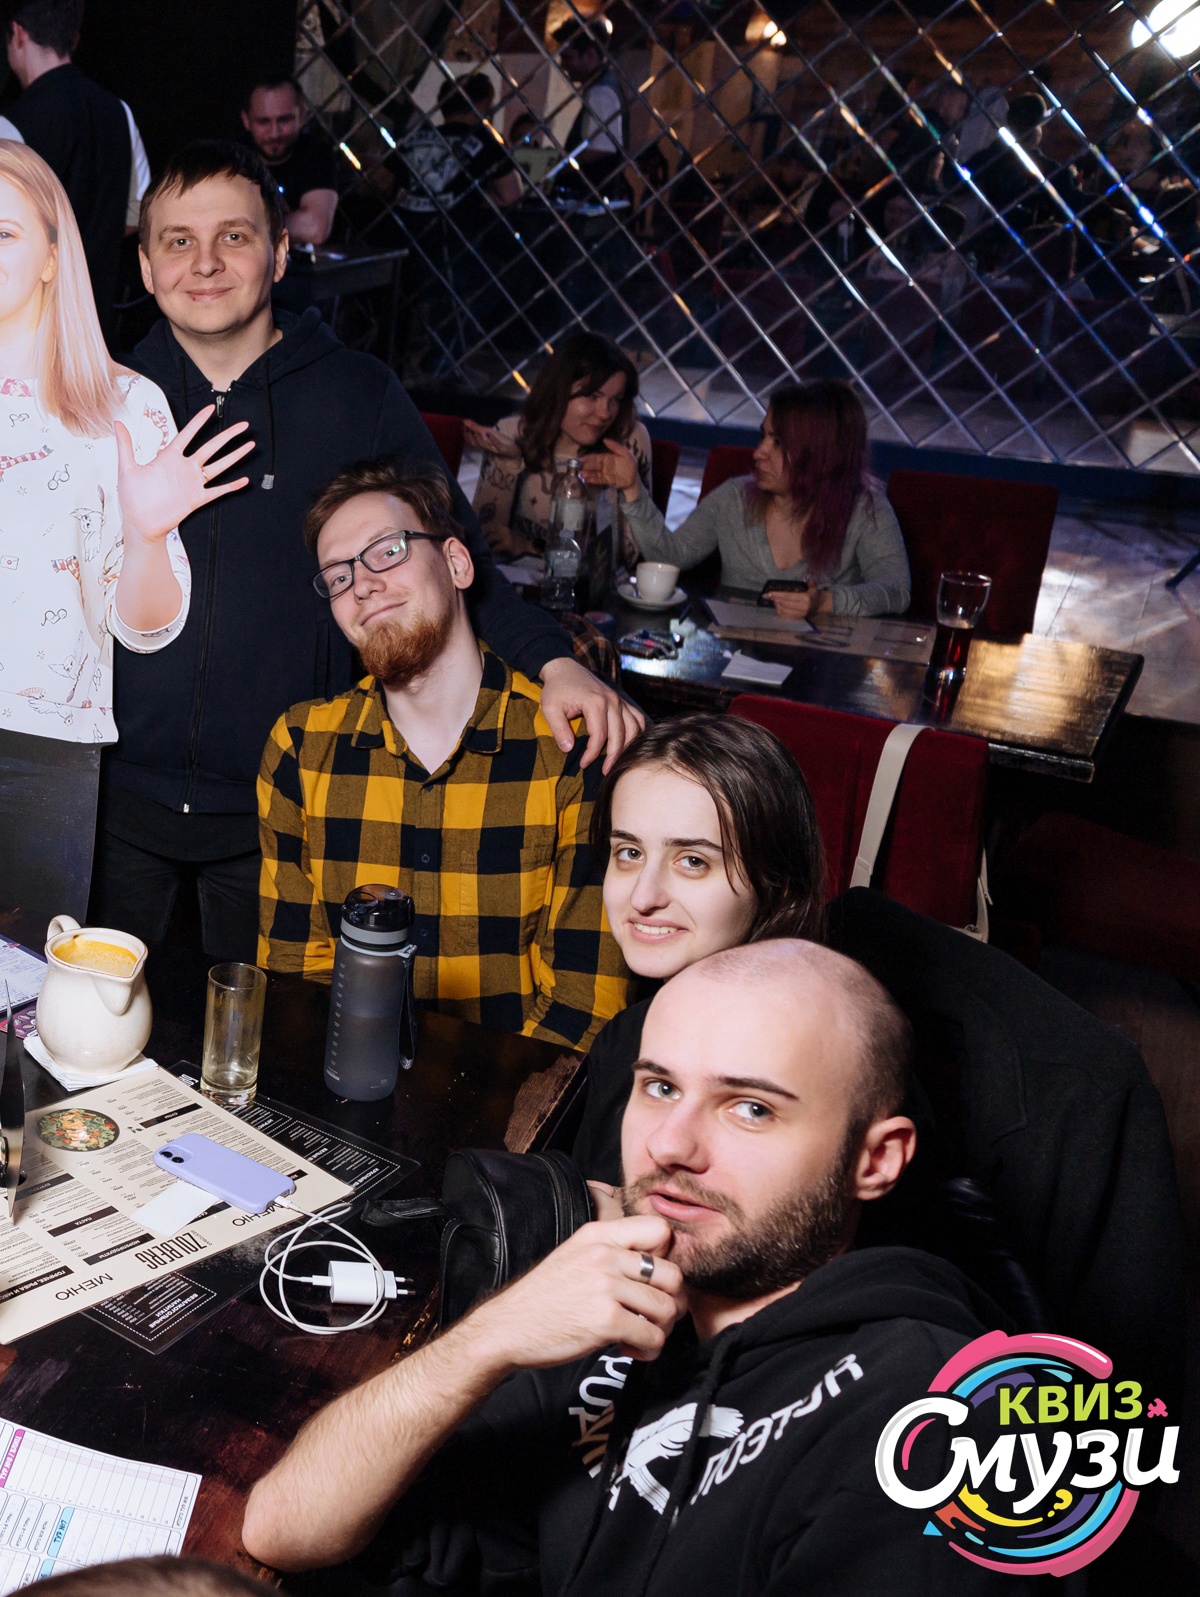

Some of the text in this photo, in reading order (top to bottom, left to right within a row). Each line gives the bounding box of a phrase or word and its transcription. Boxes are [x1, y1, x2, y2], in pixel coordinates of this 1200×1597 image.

[73, 1215, 93, 1225] ПАСТА
[97, 1238, 141, 1259] МОРЕПРОДУКТЫ
[133, 1231, 207, 1272] ZOLBERG
[19, 1280, 39, 1291] РЫБА
[53, 1271, 114, 1302] МЕНЮ
[147, 1292, 199, 1328] БЕЗАЛКОГОЛЬНЫЕ
[153, 1297, 182, 1317] НАПИТКИ
[8, 1434, 22, 1455] БЛИЦ
[52, 1519, 67, 1542] ТУР №7
